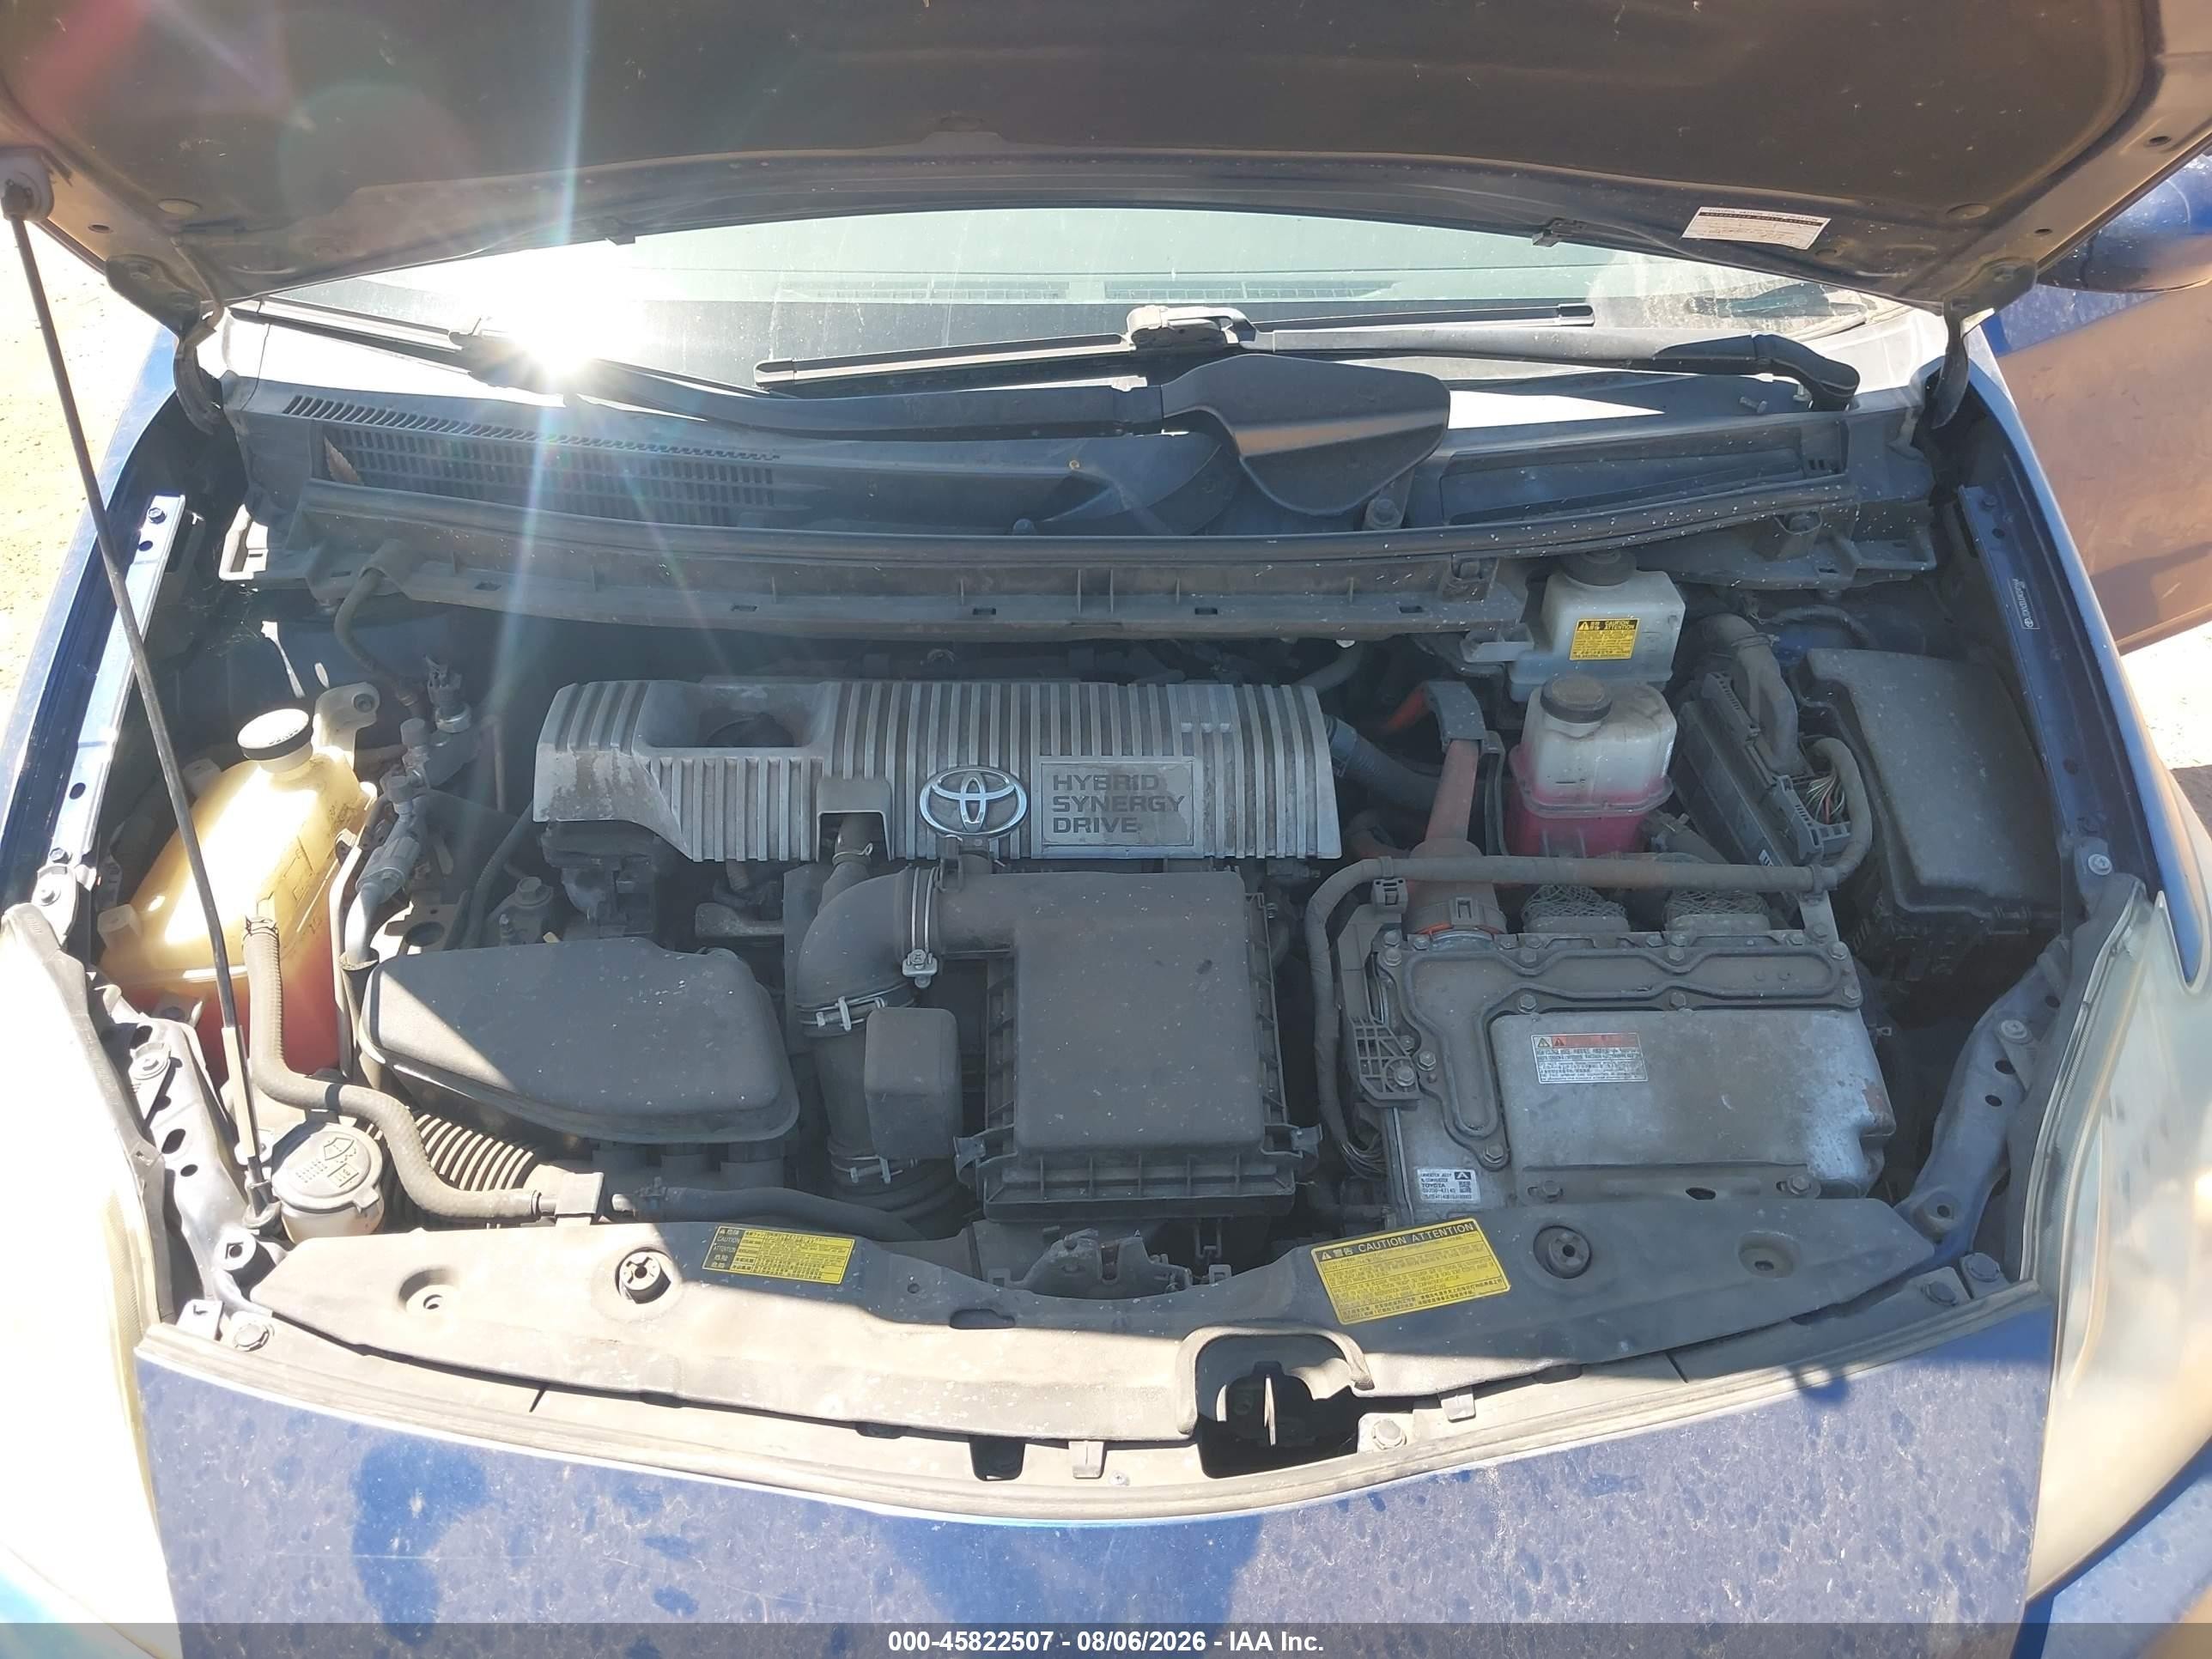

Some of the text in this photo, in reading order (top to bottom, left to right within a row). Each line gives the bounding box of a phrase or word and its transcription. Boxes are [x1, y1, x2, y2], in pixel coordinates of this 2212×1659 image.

[1053, 775, 1159, 791] HYBRID
[1052, 796, 1185, 812] SYNERGY
[1053, 817, 1138, 833] DRIVE
[1358, 1223, 1475, 1253] CAUTION ATTENTION
